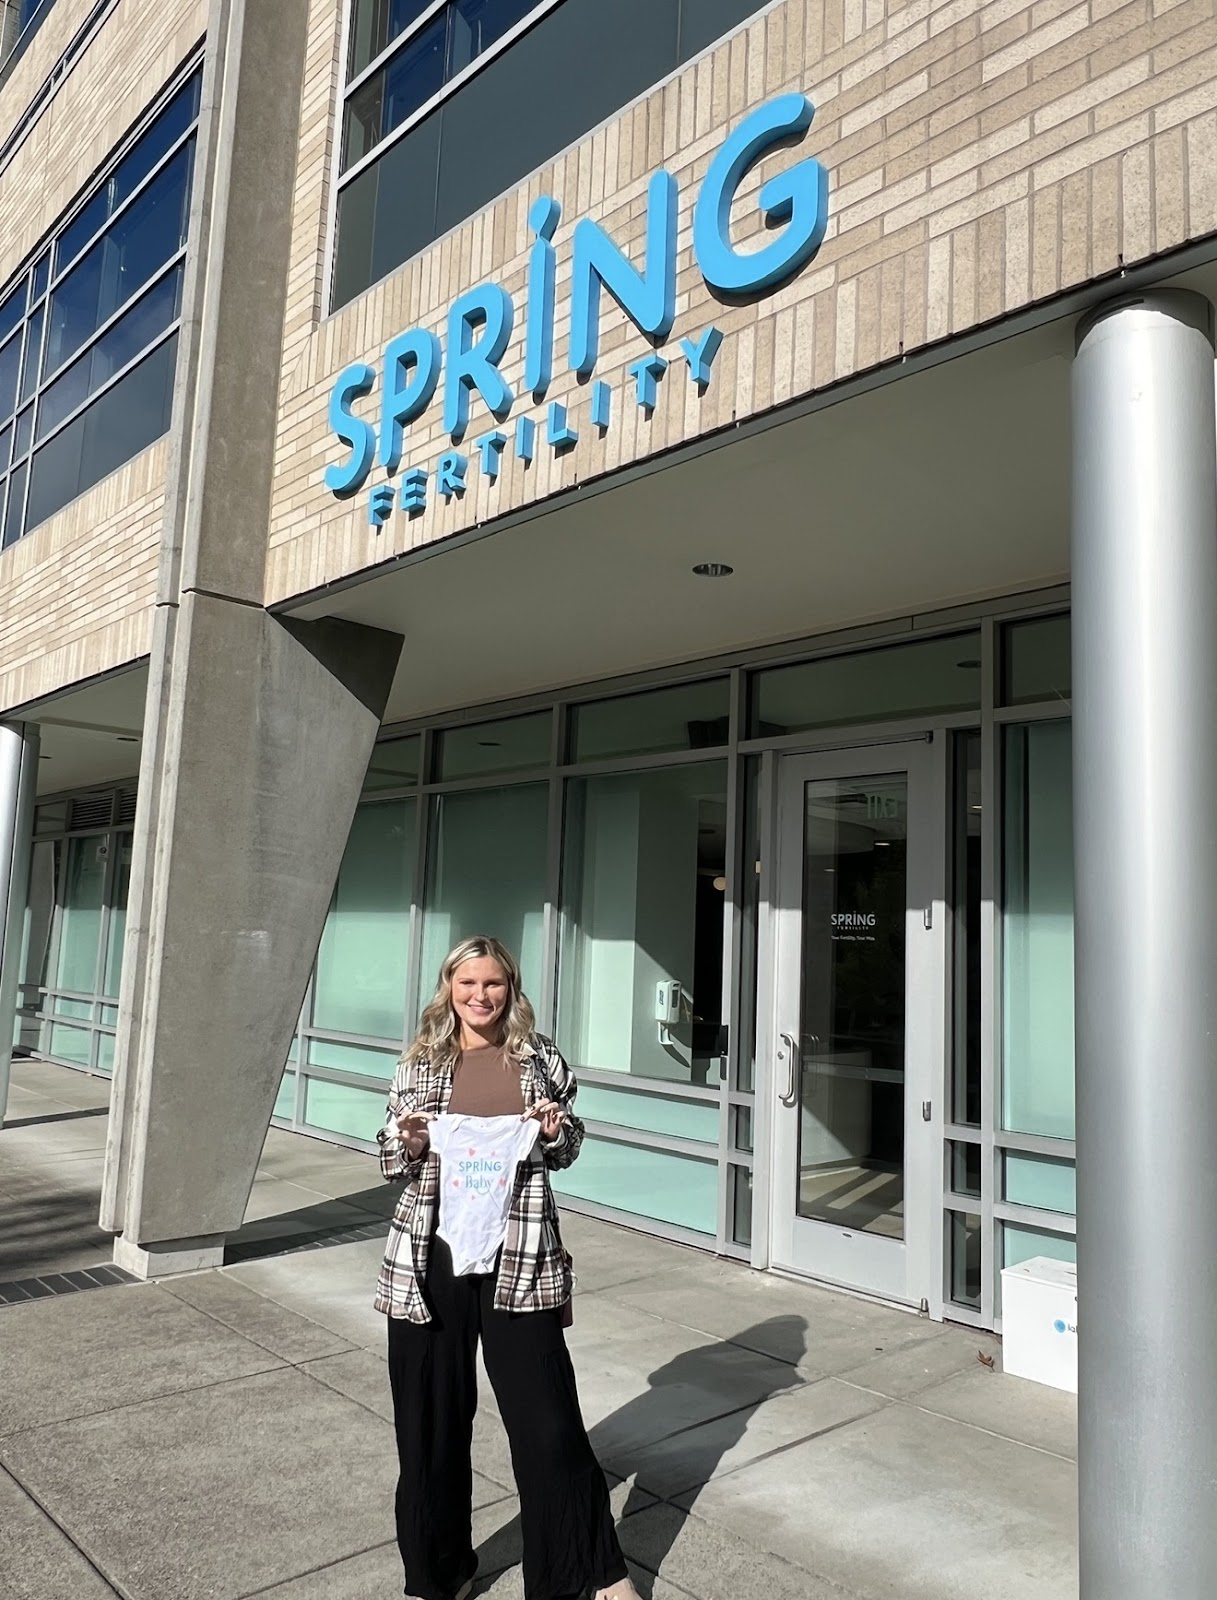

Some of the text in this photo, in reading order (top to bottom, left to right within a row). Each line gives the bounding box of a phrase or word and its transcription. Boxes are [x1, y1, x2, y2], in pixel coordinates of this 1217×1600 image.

[324, 92, 829, 497] SPRING
[369, 326, 724, 527] FERTILITY
[830, 911, 876, 926] SPRING
[459, 1158, 502, 1172] SPRING
[465, 1175, 495, 1195] Baby
